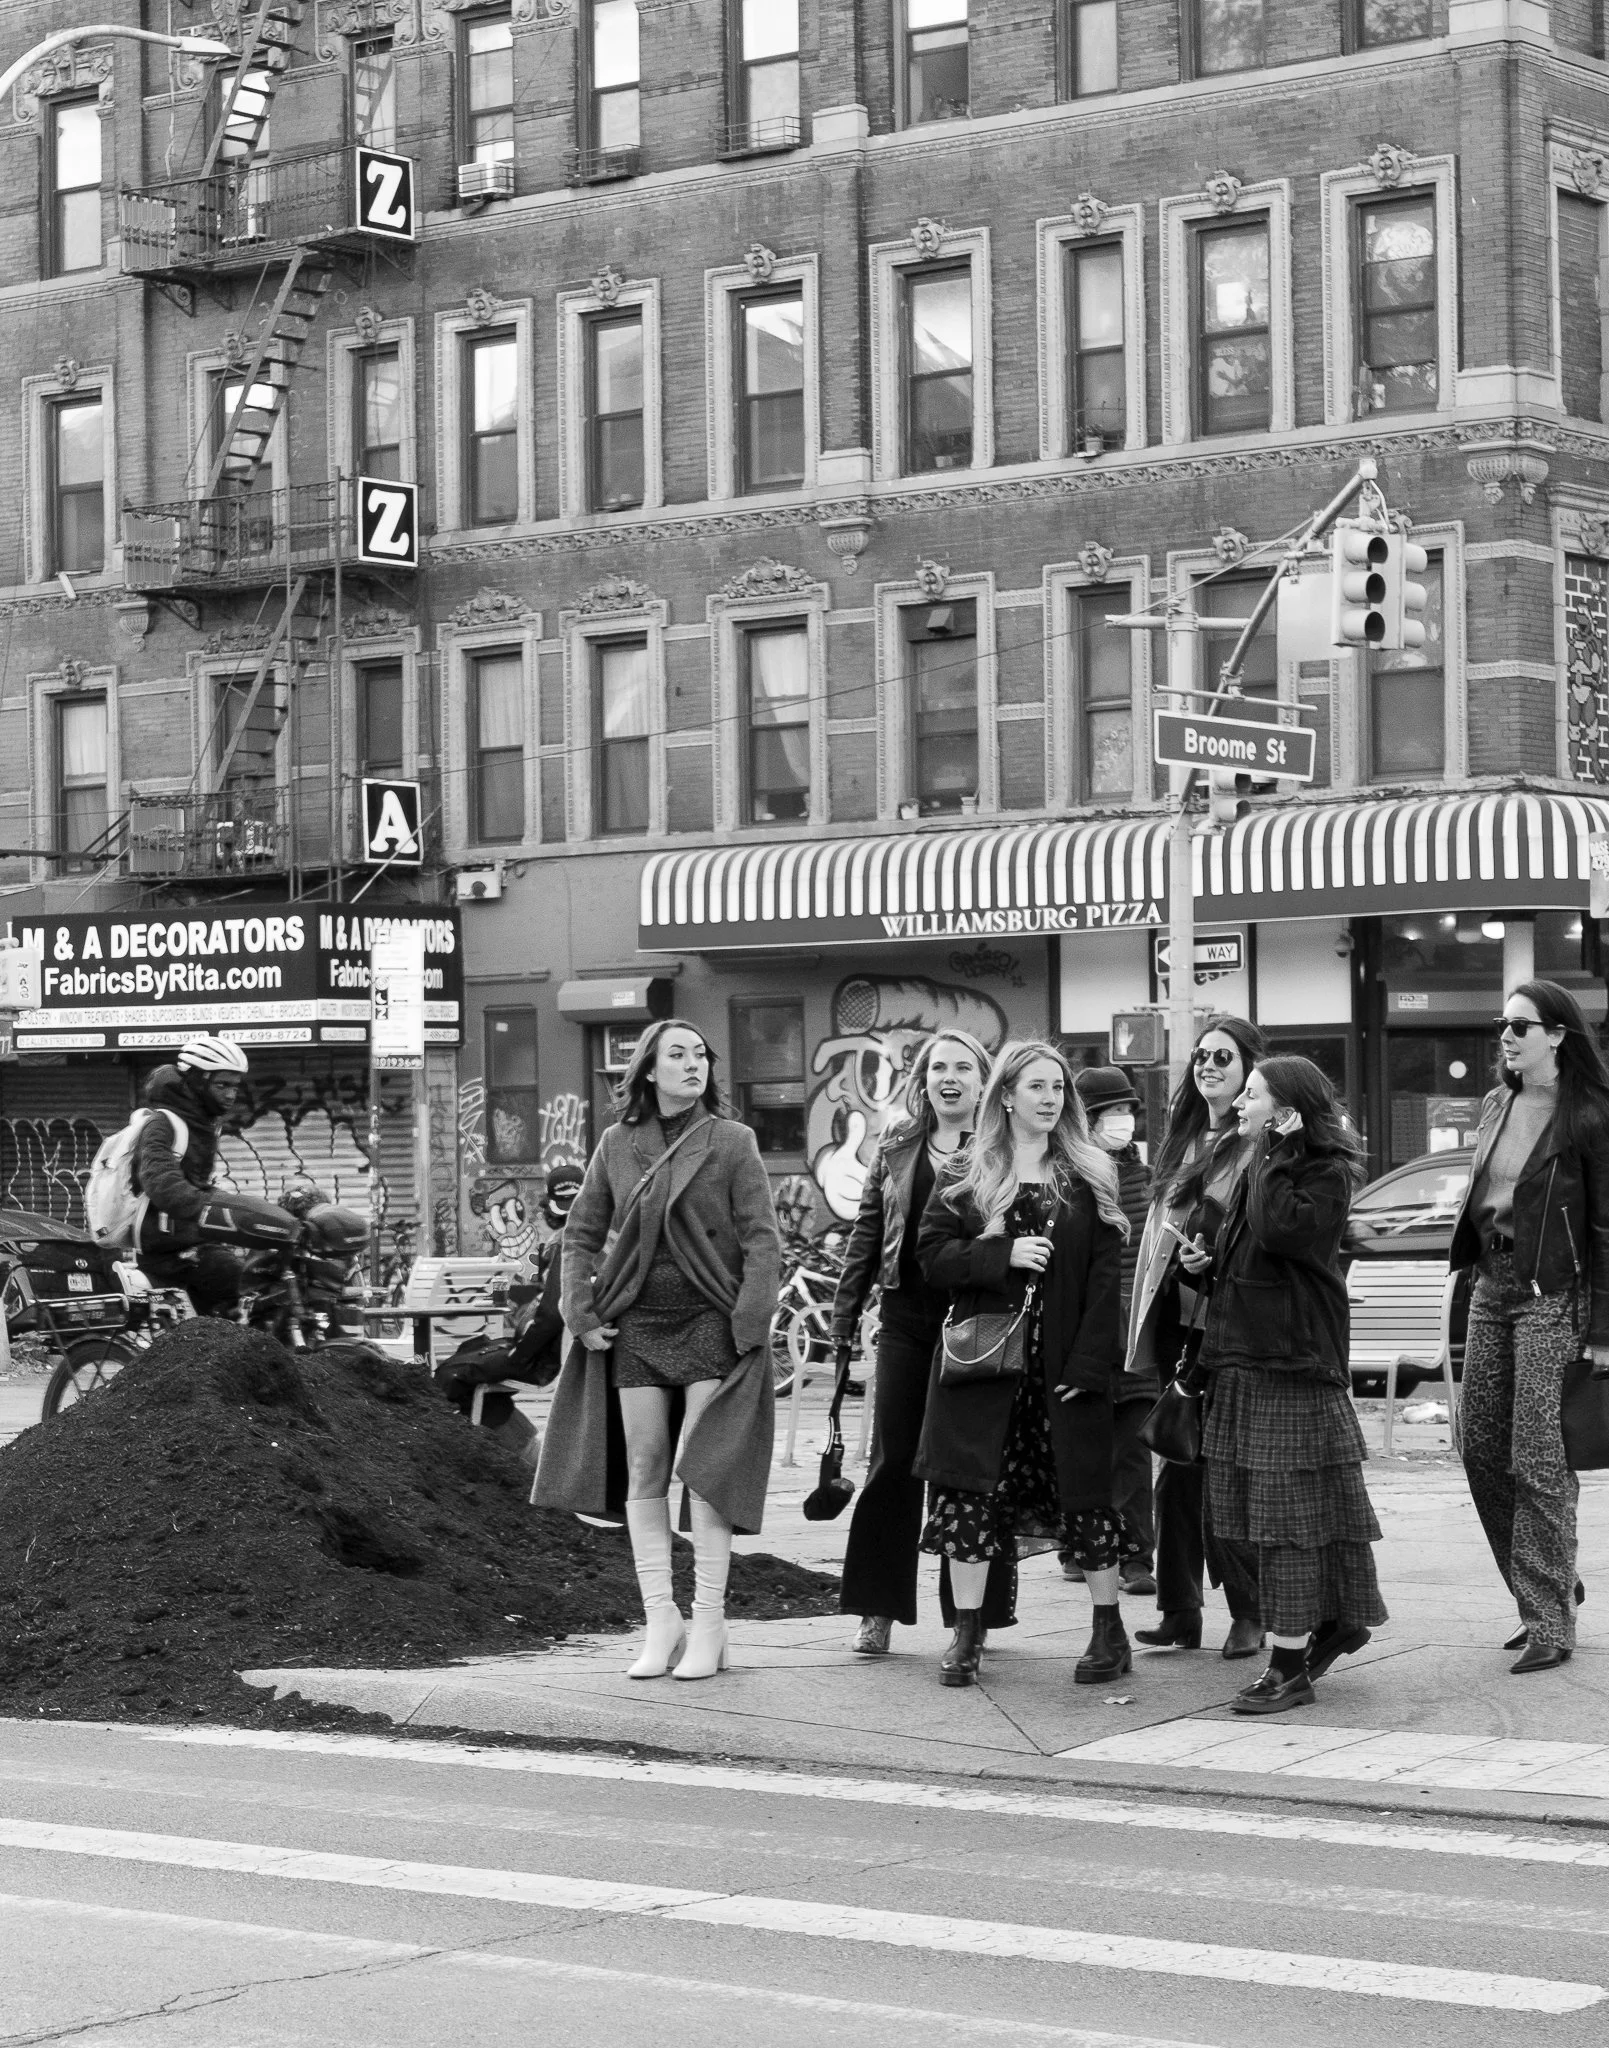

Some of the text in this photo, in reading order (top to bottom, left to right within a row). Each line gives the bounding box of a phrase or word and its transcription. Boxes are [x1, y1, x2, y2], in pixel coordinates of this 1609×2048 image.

[366, 160, 407, 229] Z
[368, 488, 410, 556] Z
[1184, 727, 1287, 765] Broome St
[370, 790, 418, 854] A
[22, 915, 305, 960] M & A DECORATORS
[320, 914, 333, 950] M
[336, 915, 348, 951] &
[350, 916, 362, 951] A
[881, 902, 1163, 938] WILLIAMSBURG PIZZA
[1207, 945, 1234, 960] WAY
[45, 962, 282, 1000] FabricsByRita.com
[222, 1029, 308, 1042] 917-699-8724
